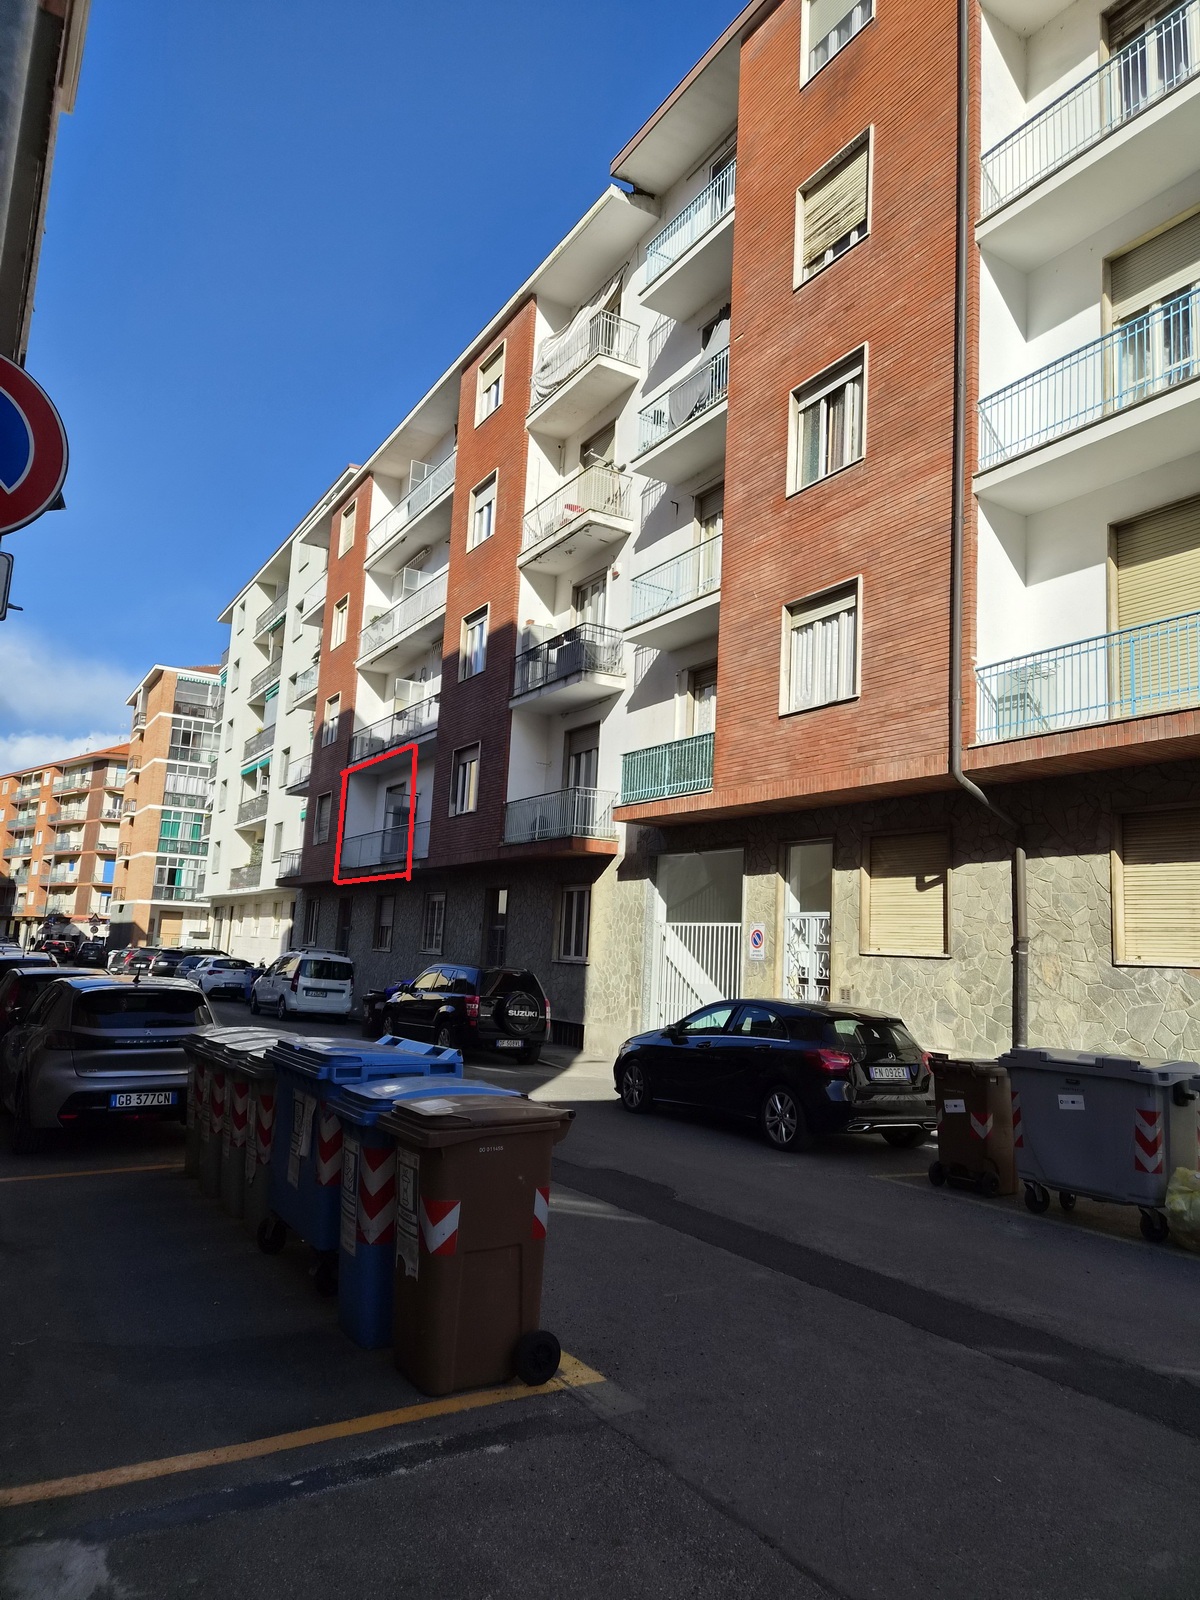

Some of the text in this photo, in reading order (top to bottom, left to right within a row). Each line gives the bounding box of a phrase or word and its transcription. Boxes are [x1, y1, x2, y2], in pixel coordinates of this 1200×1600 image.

[508, 1009, 538, 1018] SUZUKI
[874, 1067, 906, 1077] FN 092EX
[118, 1092, 171, 1106] GB 377CN
